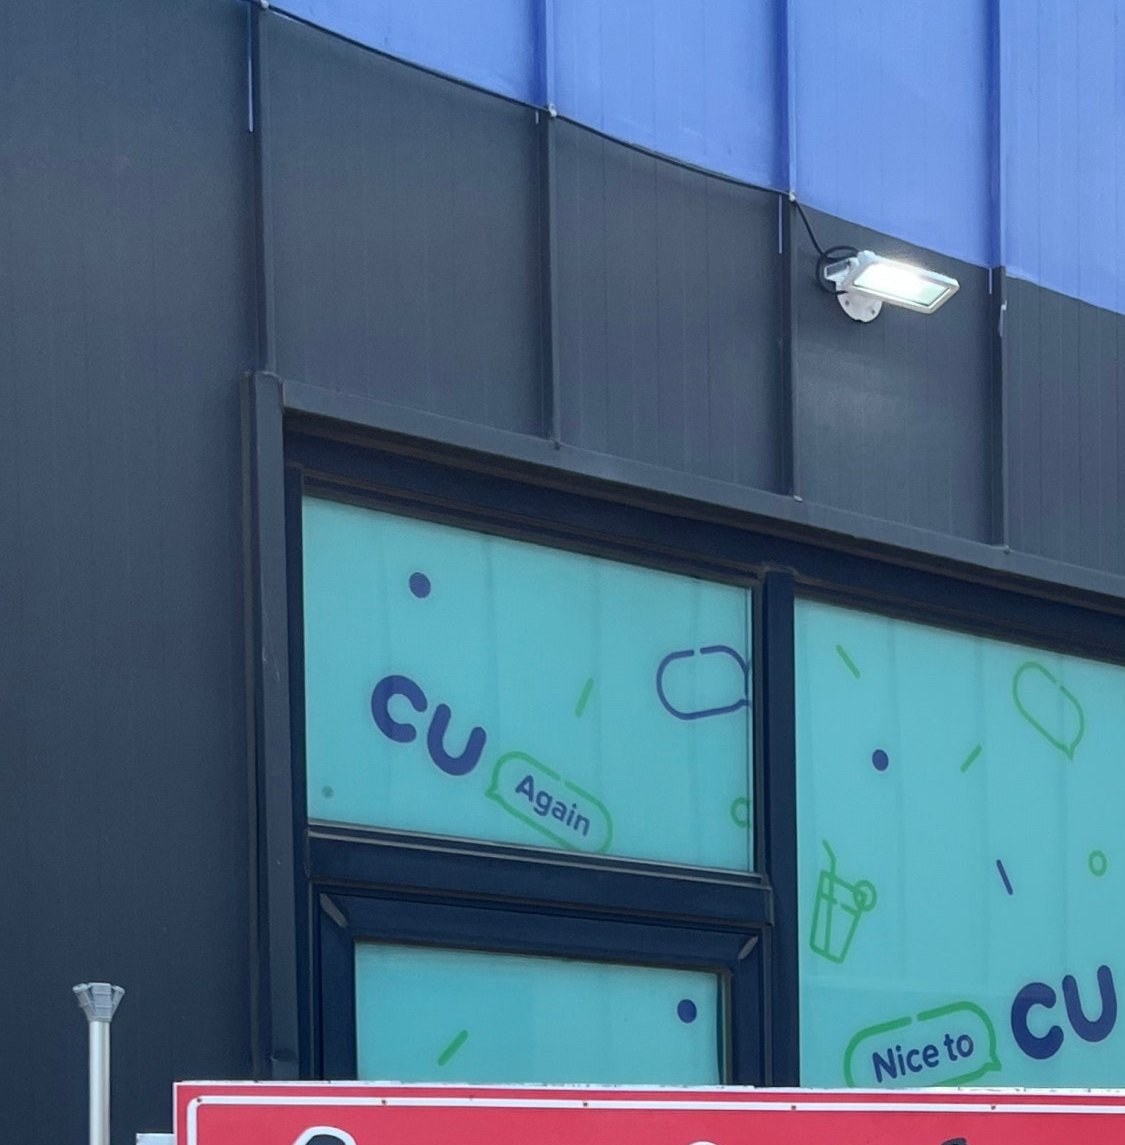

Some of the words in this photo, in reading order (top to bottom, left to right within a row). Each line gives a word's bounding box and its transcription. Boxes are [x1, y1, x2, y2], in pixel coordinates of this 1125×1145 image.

[370, 674, 488, 777] CU
[514, 774, 591, 837] Again
[871, 1043, 940, 1084] Nice
[942, 1033, 975, 1062] to
[1009, 964, 1118, 1061] CU
